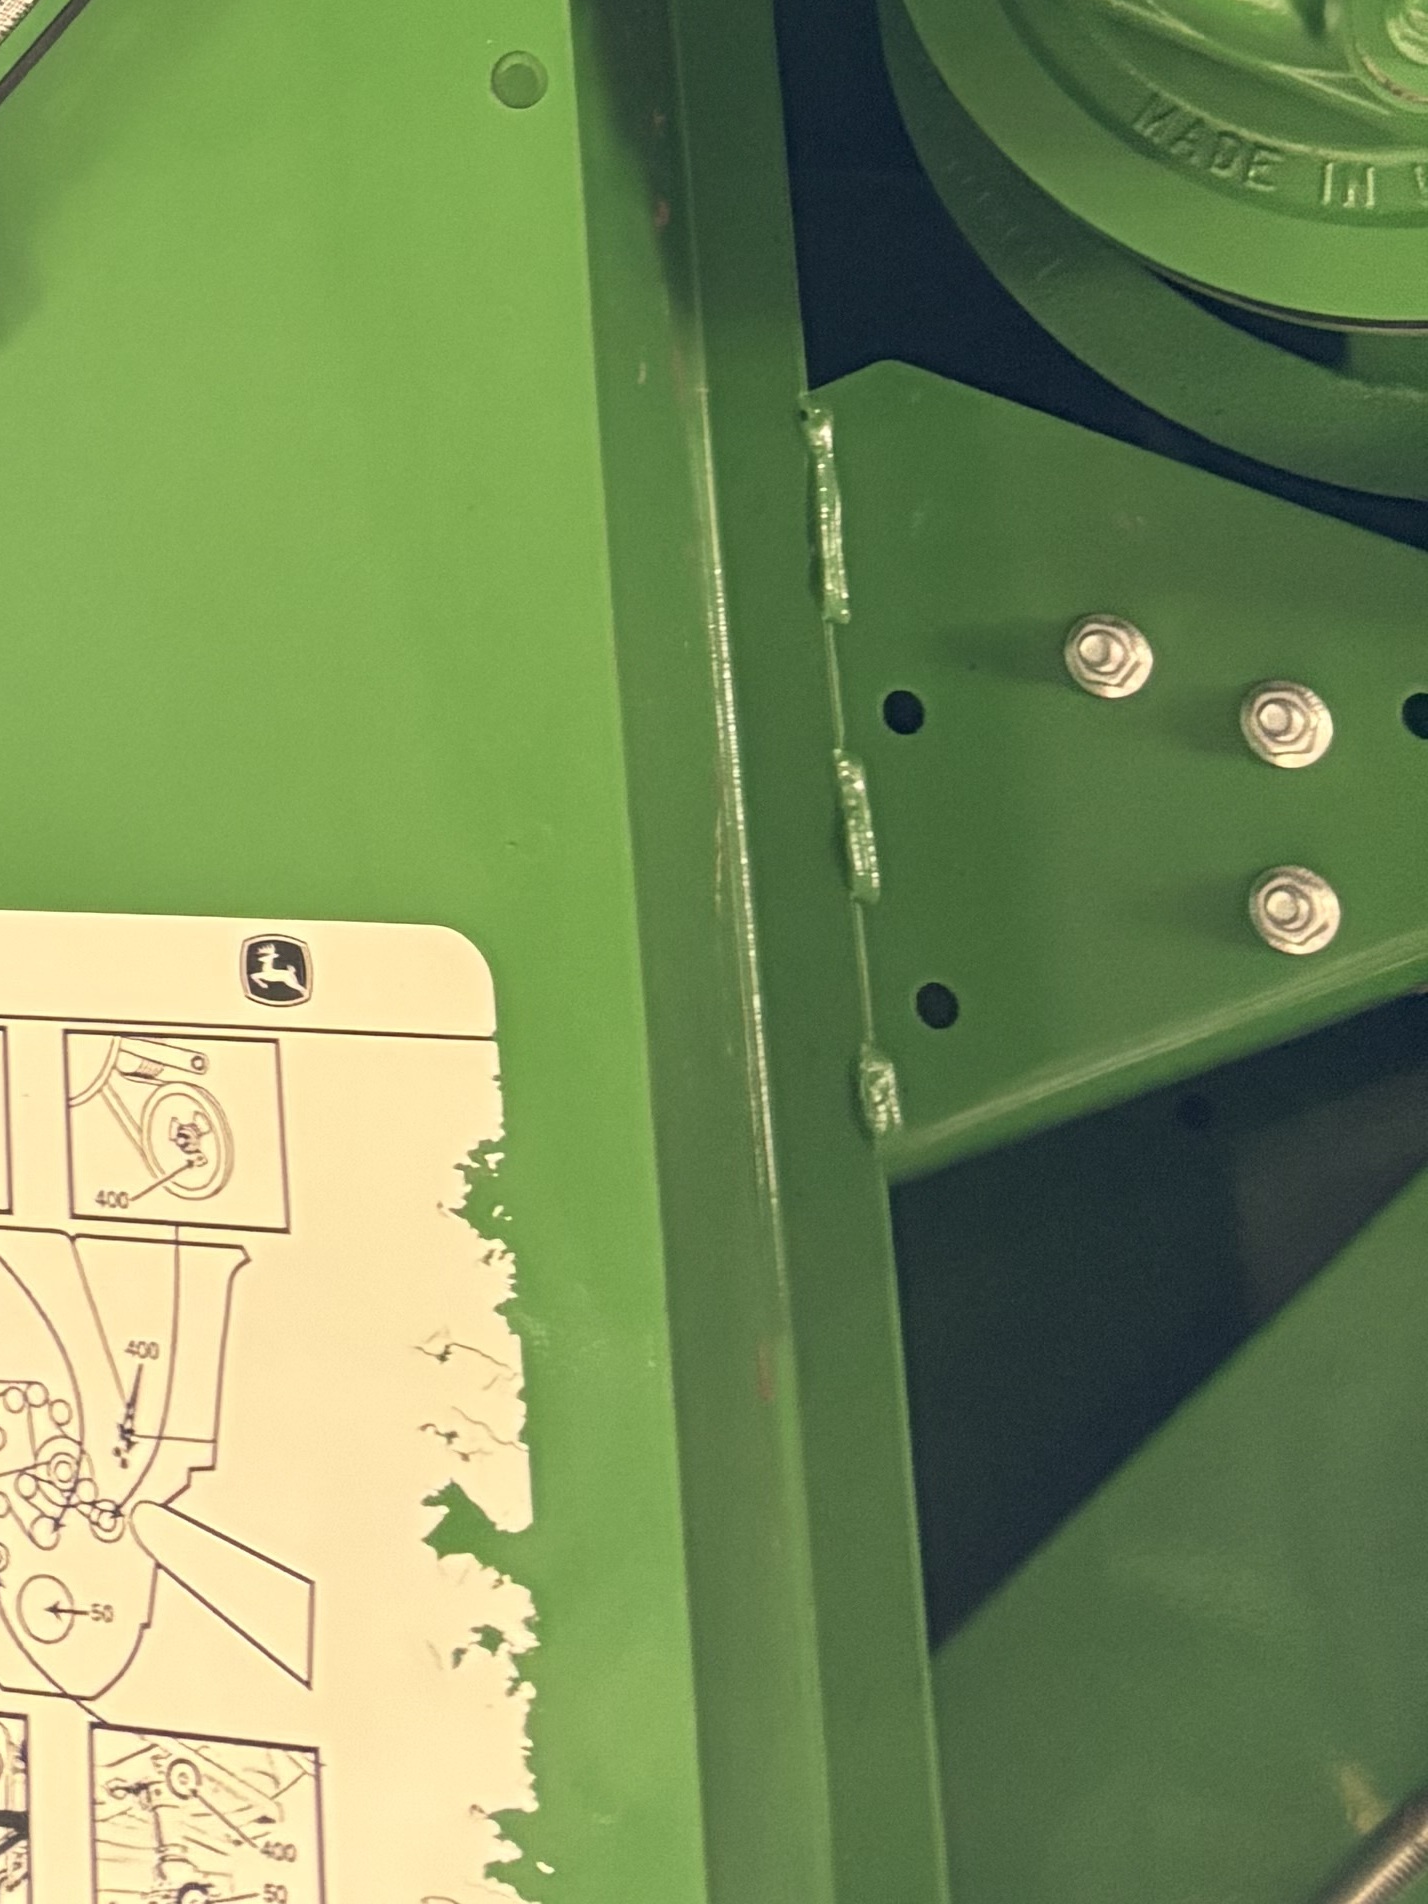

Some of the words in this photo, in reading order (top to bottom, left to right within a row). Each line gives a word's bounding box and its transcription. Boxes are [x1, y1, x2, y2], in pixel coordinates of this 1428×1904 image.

[1133, 92, 1285, 193] MADE
[1322, 161, 1376, 209] IN
[94, 1190, 130, 1210] 400
[123, 1340, 160, 1360] 400
[90, 1603, 114, 1623] 50
[260, 1841, 298, 1863] 400
[263, 1883, 288, 1904] 50
